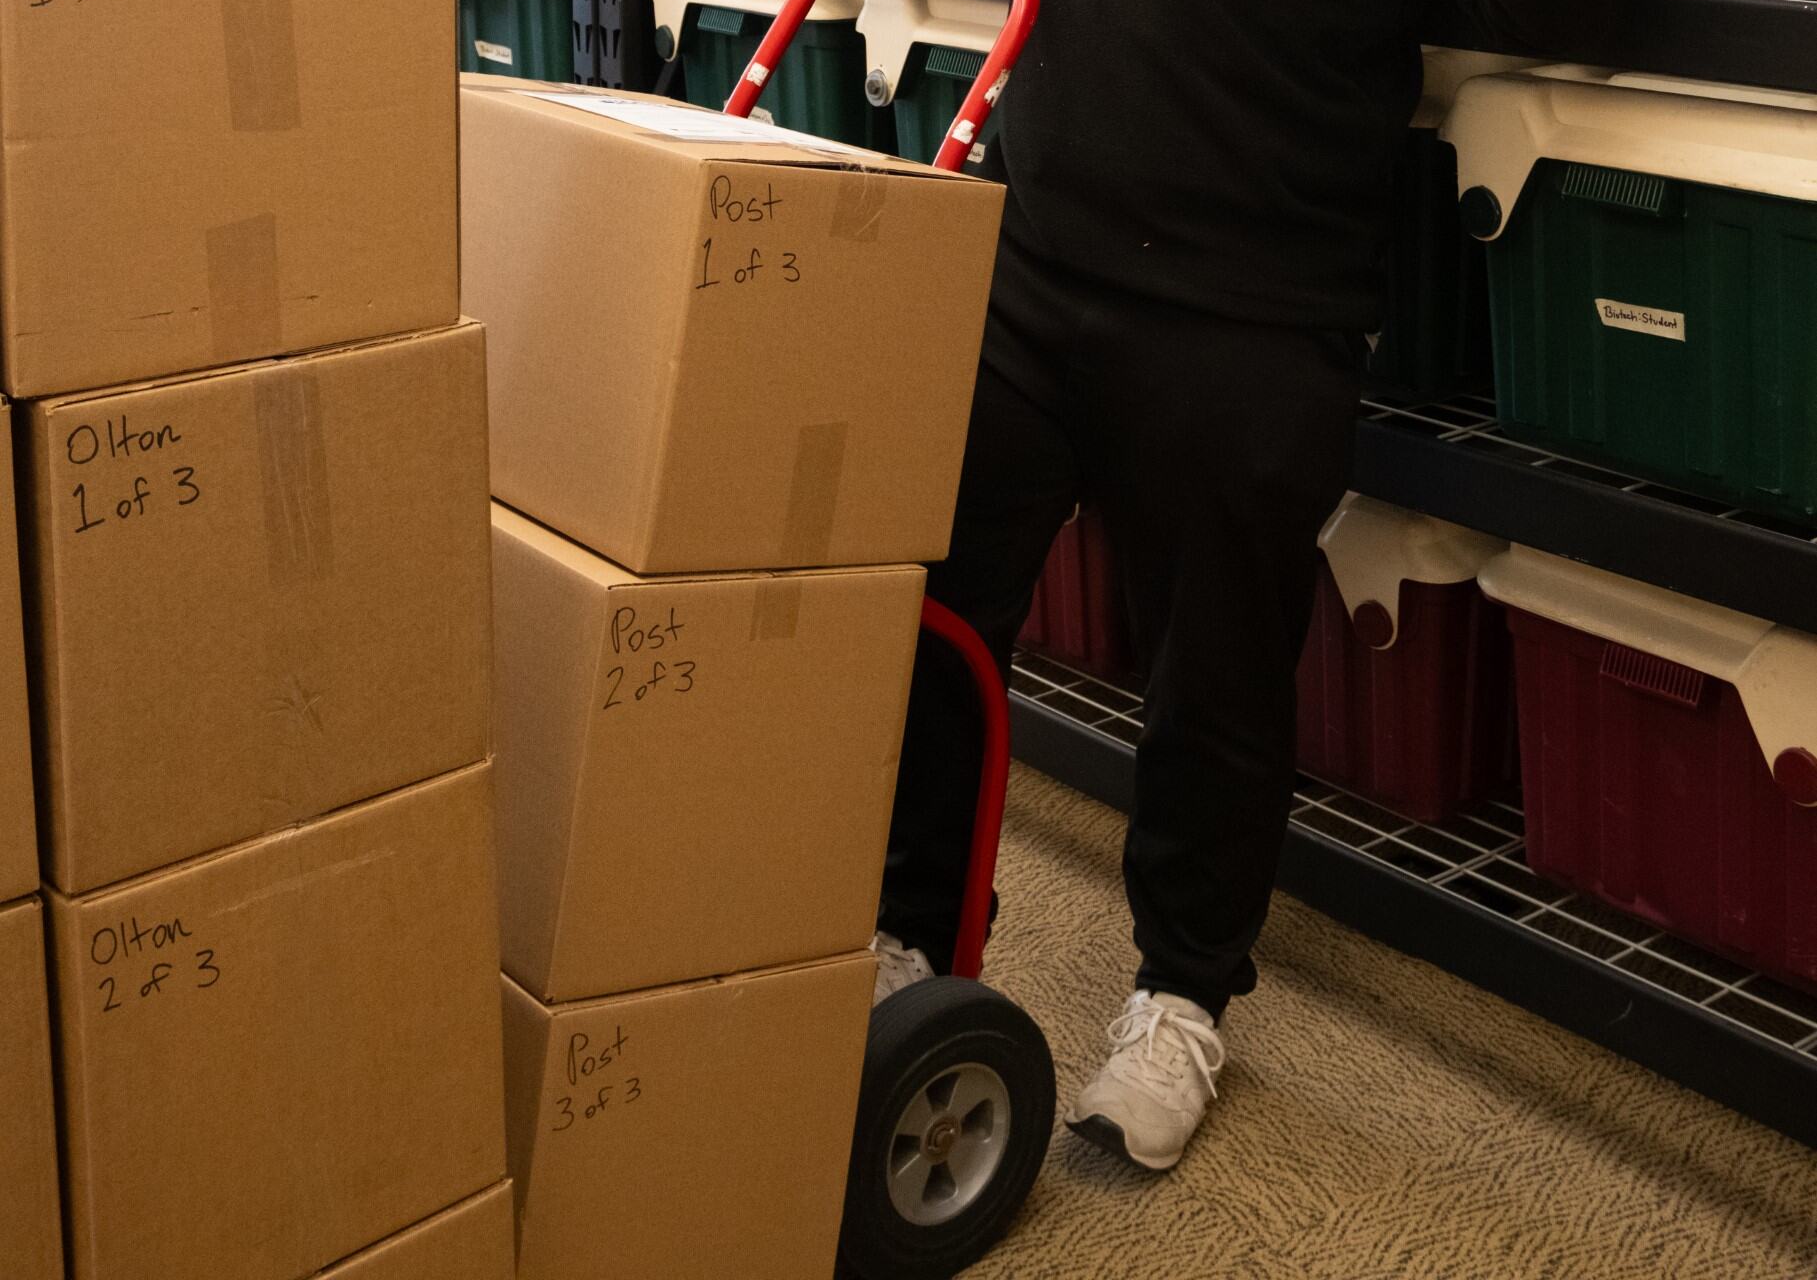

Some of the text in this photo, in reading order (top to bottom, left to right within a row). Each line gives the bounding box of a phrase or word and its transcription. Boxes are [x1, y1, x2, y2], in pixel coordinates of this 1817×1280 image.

[710, 174, 783, 222] Post
[695, 237, 801, 290] 1 of 3
[1641, 312, 1678, 329] Student
[67, 414, 182, 465] Olton
[72, 466, 200, 533] 1 of 3
[611, 606, 685, 654] Post
[602, 660, 696, 710] 2 of 3
[90, 917, 193, 966] Olton
[98, 948, 221, 1012] 2 of 3
[567, 1024, 629, 1086] Post
[551, 1077, 642, 1132] 3 of 3
